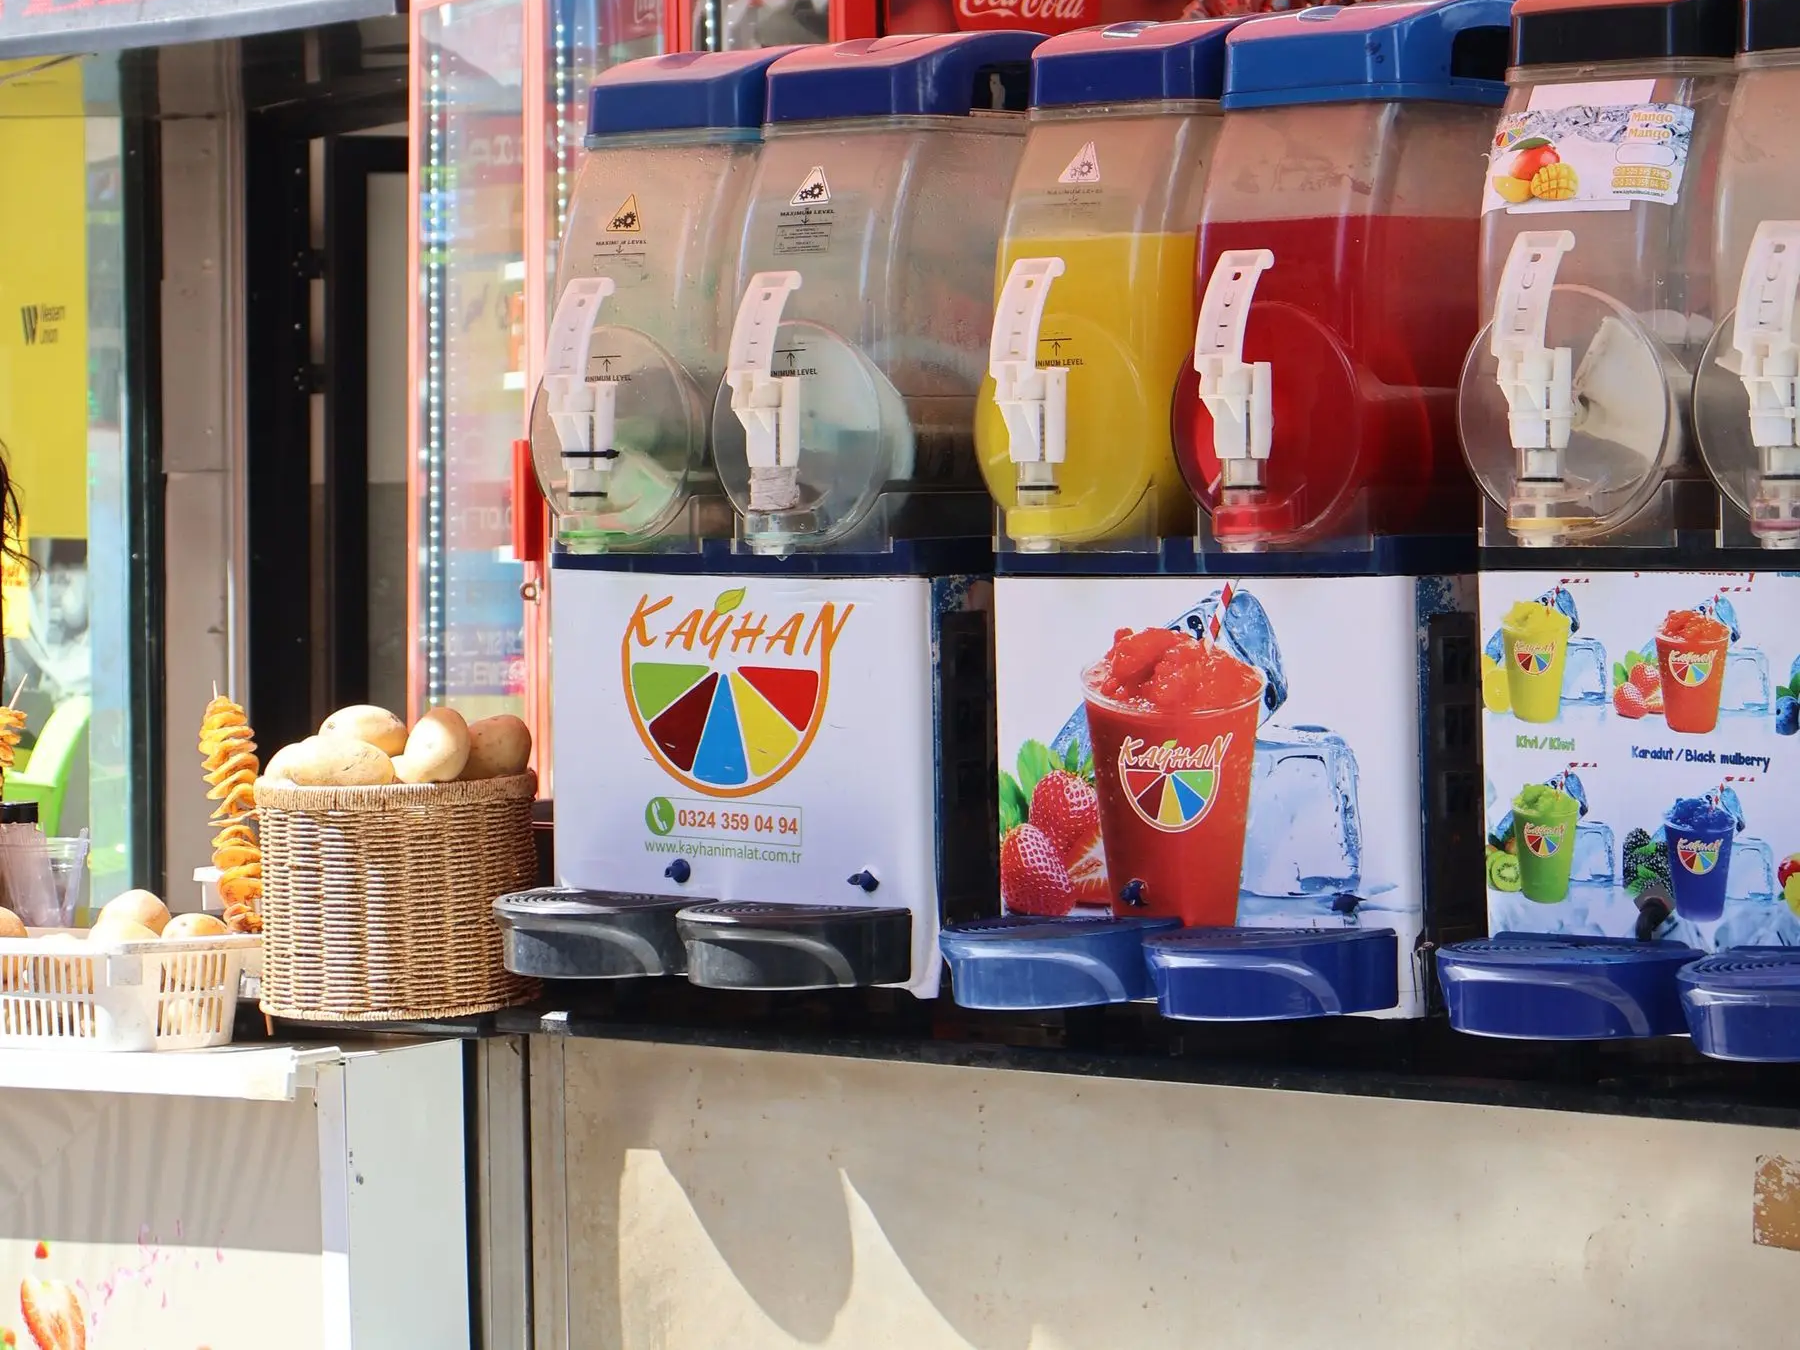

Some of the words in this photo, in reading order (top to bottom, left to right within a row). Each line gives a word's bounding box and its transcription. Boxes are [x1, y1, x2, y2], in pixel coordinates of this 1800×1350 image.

[1632, 112, 1674, 124] Mango
[1630, 129, 1670, 139] Mango
[770, 370, 796, 378] INIMUM
[797, 368, 818, 376] LEVEL
[1035, 359, 1061, 368] INIMUM
[1062, 358, 1084, 366] LEVEL
[628, 594, 854, 660] KAYHAN
[1119, 732, 1234, 771] KAYHAN
[1516, 735, 1539, 748] Kivi
[1549, 737, 1575, 752] Kiwi
[1631, 746, 1675, 762] Karadut
[1685, 750, 1716, 764] Black
[1720, 754, 1771, 773] mulberry
[678, 809, 716, 829] 0324
[721, 812, 749, 831] 359
[754, 815, 773, 833] 04
[778, 817, 798, 835] 94
[645, 839, 803, 864] www.kayhanimalat.com.tr
